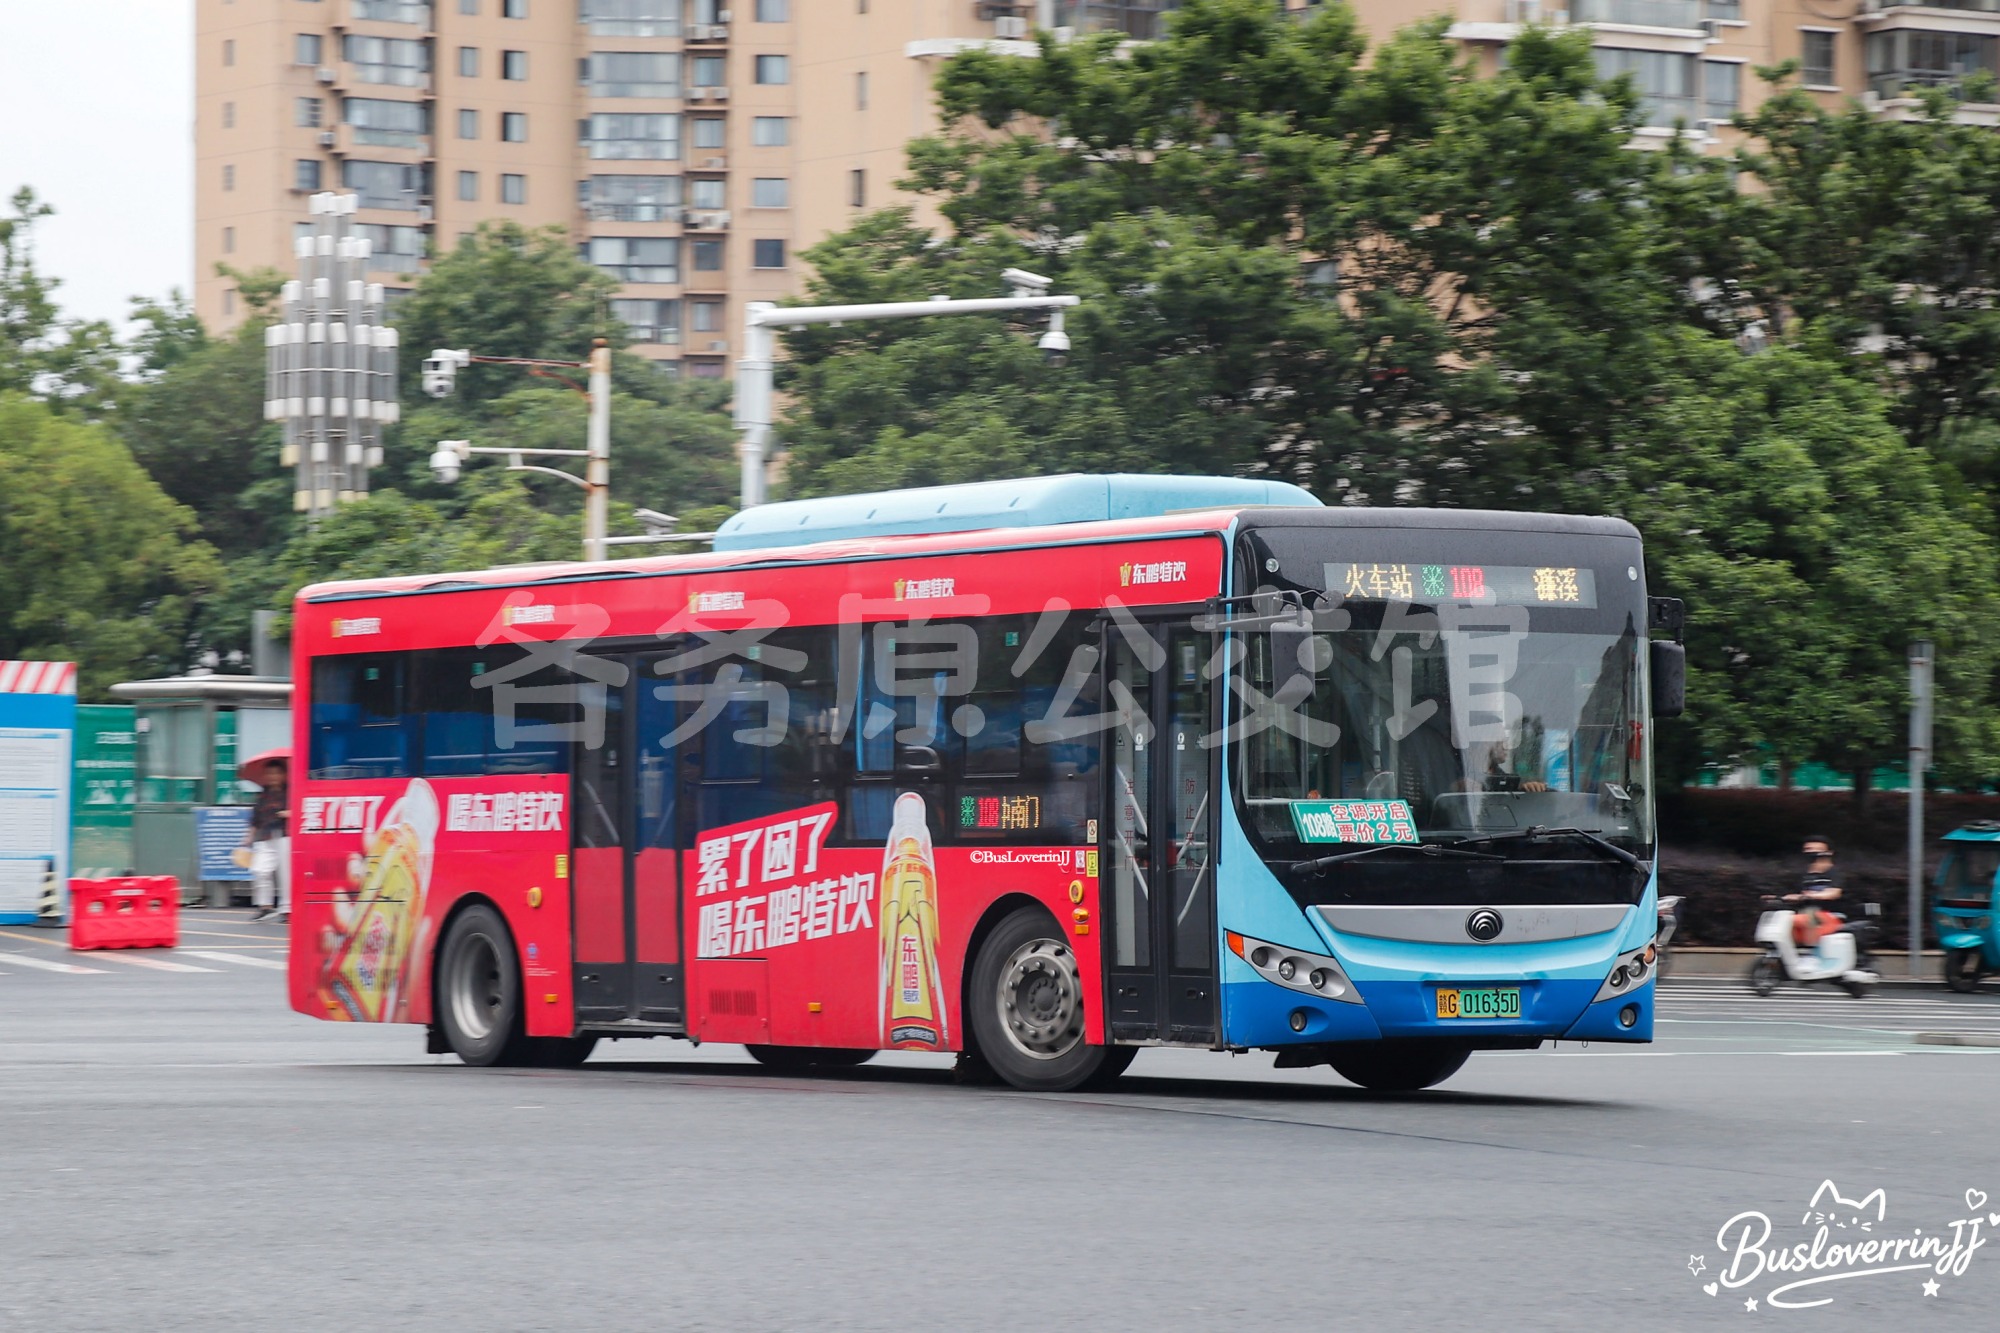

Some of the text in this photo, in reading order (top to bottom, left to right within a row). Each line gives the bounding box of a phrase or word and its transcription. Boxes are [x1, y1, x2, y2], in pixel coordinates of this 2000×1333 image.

[1132, 561, 1186, 584] 东鹏特饮
[1345, 564, 1412, 598] 火车站
[1450, 567, 1485, 598] 108
[904, 578, 955, 600] 东鹏特饮
[1302, 812, 1340, 838] 108路
[1330, 803, 1409, 821] 空调开启
[696, 812, 832, 897] 累了困了
[696, 872, 875, 958] 喝东鹏特饮
